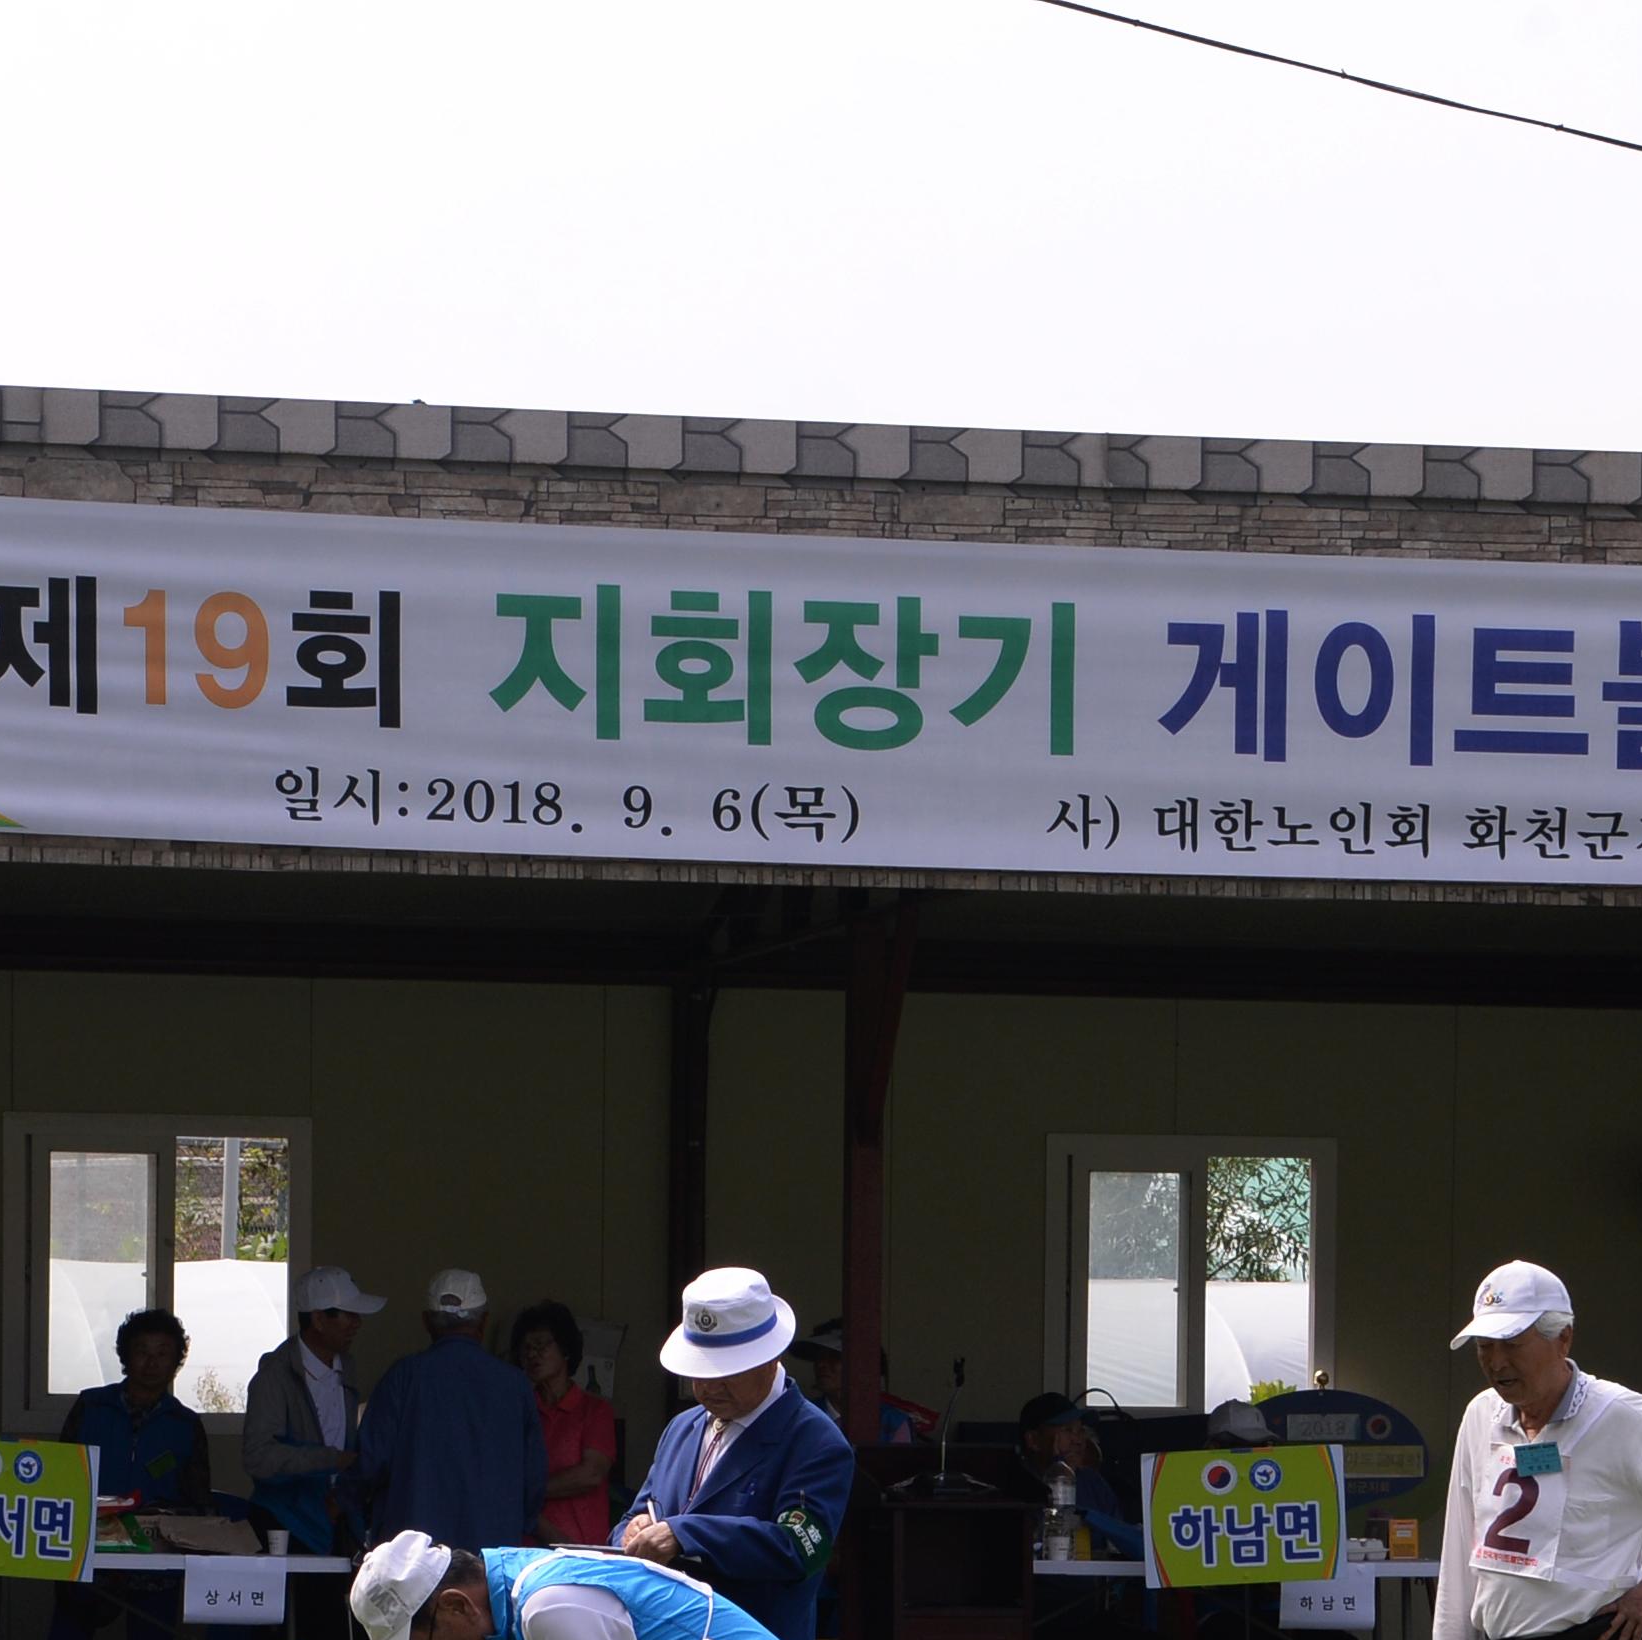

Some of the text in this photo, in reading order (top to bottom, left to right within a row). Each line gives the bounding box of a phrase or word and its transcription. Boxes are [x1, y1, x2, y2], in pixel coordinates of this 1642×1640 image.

[488, 583, 1076, 756] 지회장기
[711, 782, 860, 844] 6(목)
[1045, 793, 1121, 851] 사)
[1153, 797, 1433, 859] 대한노인회
[1168, 1500, 1324, 1568] 하남면
[1484, 1467, 1540, 1554] 2
